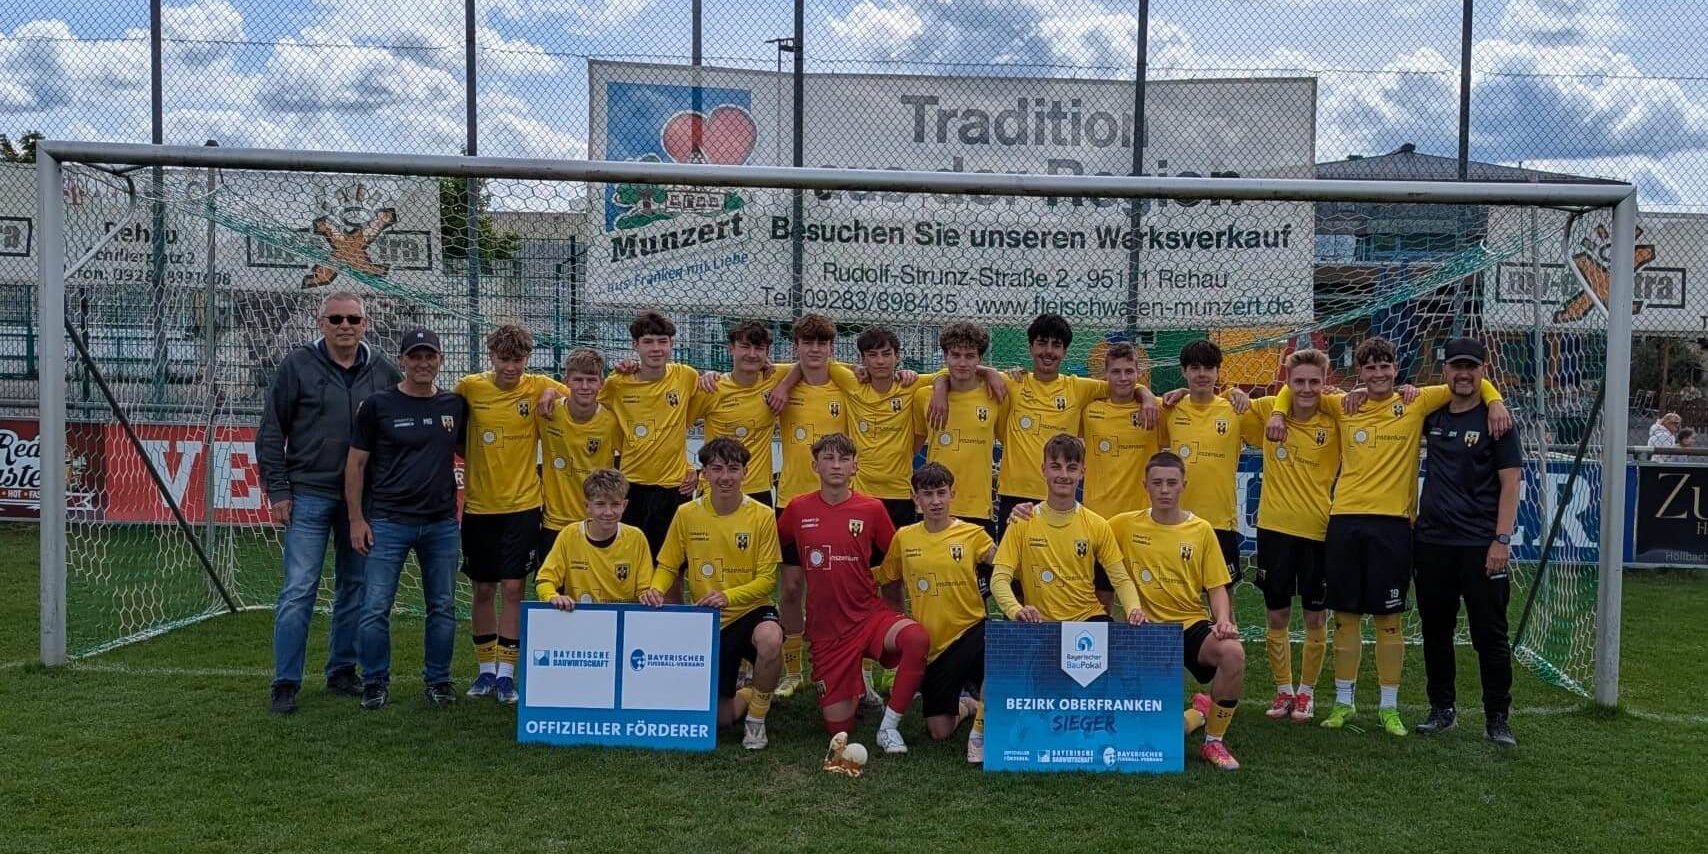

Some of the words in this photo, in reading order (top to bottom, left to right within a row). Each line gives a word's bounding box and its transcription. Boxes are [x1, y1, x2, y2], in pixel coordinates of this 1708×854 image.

[901, 95, 1149, 147] Tradition
[104, 221, 177, 244] Rehu
[611, 213, 743, 262] Munzert
[771, 216, 905, 243] Besuchen
[915, 221, 960, 246] Sie
[970, 226, 1086, 249] unseren
[1096, 223, 1292, 249] Werksverkauf
[635, 265, 683, 286] Franken
[686, 260, 711, 276] mit
[714, 253, 749, 270] Liebe
[823, 262, 1049, 289] Rudolf-Strunz-Straße
[1056, 269, 1070, 288] 2
[1087, 269, 1149, 290] 9511
[1159, 269, 1228, 289] Rehau
[975, 293, 1295, 318] www.fleischwaen-munzert.de
[8, 489, 21, 498] HOT
[1389, 588, 1400, 598] 19
[553, 650, 610, 659] BAYERISCHE
[647, 653, 705, 662] BAYERISCHER
[1066, 653, 1103, 662] Bayerischer
[553, 659, 610, 668] BAUWIRTSCHAFT
[1066, 661, 1103, 670] BauPokal
[1006, 698, 1055, 710] BEZIRK
[1059, 698, 1163, 712] OBERFRANKEN
[526, 720, 621, 737] OFFIZIELLER
[626, 720, 709, 738] FÖRDERER
[1052, 714, 1117, 734] SIEGER
[1052, 749, 1094, 757] BAYERISCHE
